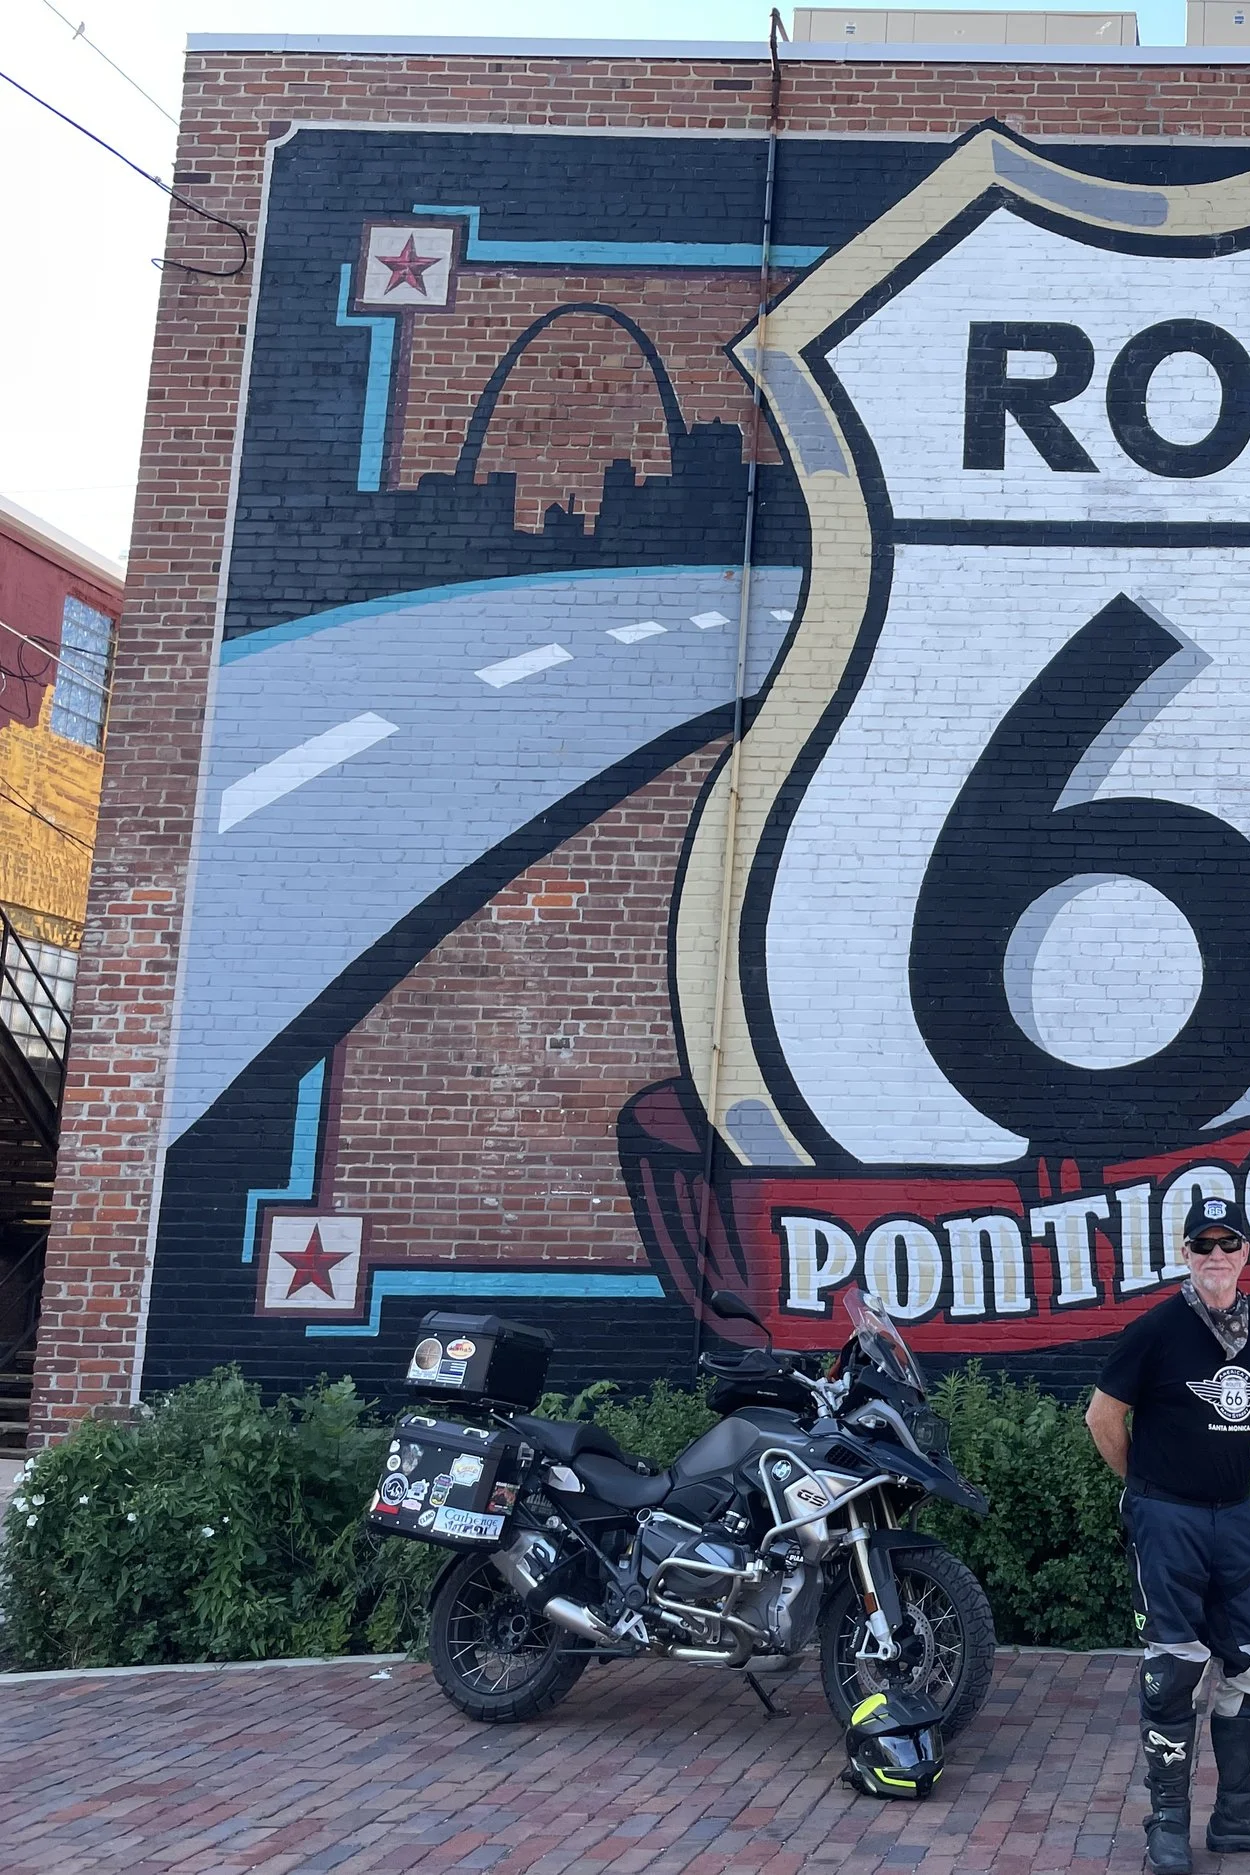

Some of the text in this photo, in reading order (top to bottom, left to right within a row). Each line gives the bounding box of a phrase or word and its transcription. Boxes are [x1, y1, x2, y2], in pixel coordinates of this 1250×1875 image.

[1225, 1391, 1243, 1406] 66
[1208, 1423, 1227, 1432] SANTA
[1228, 1424, 1250, 1432] MONICA
[797, 1489, 827, 1507] GS
[444, 1508, 498, 1527] Carhenge
[789, 1554, 804, 1563] PIAA
